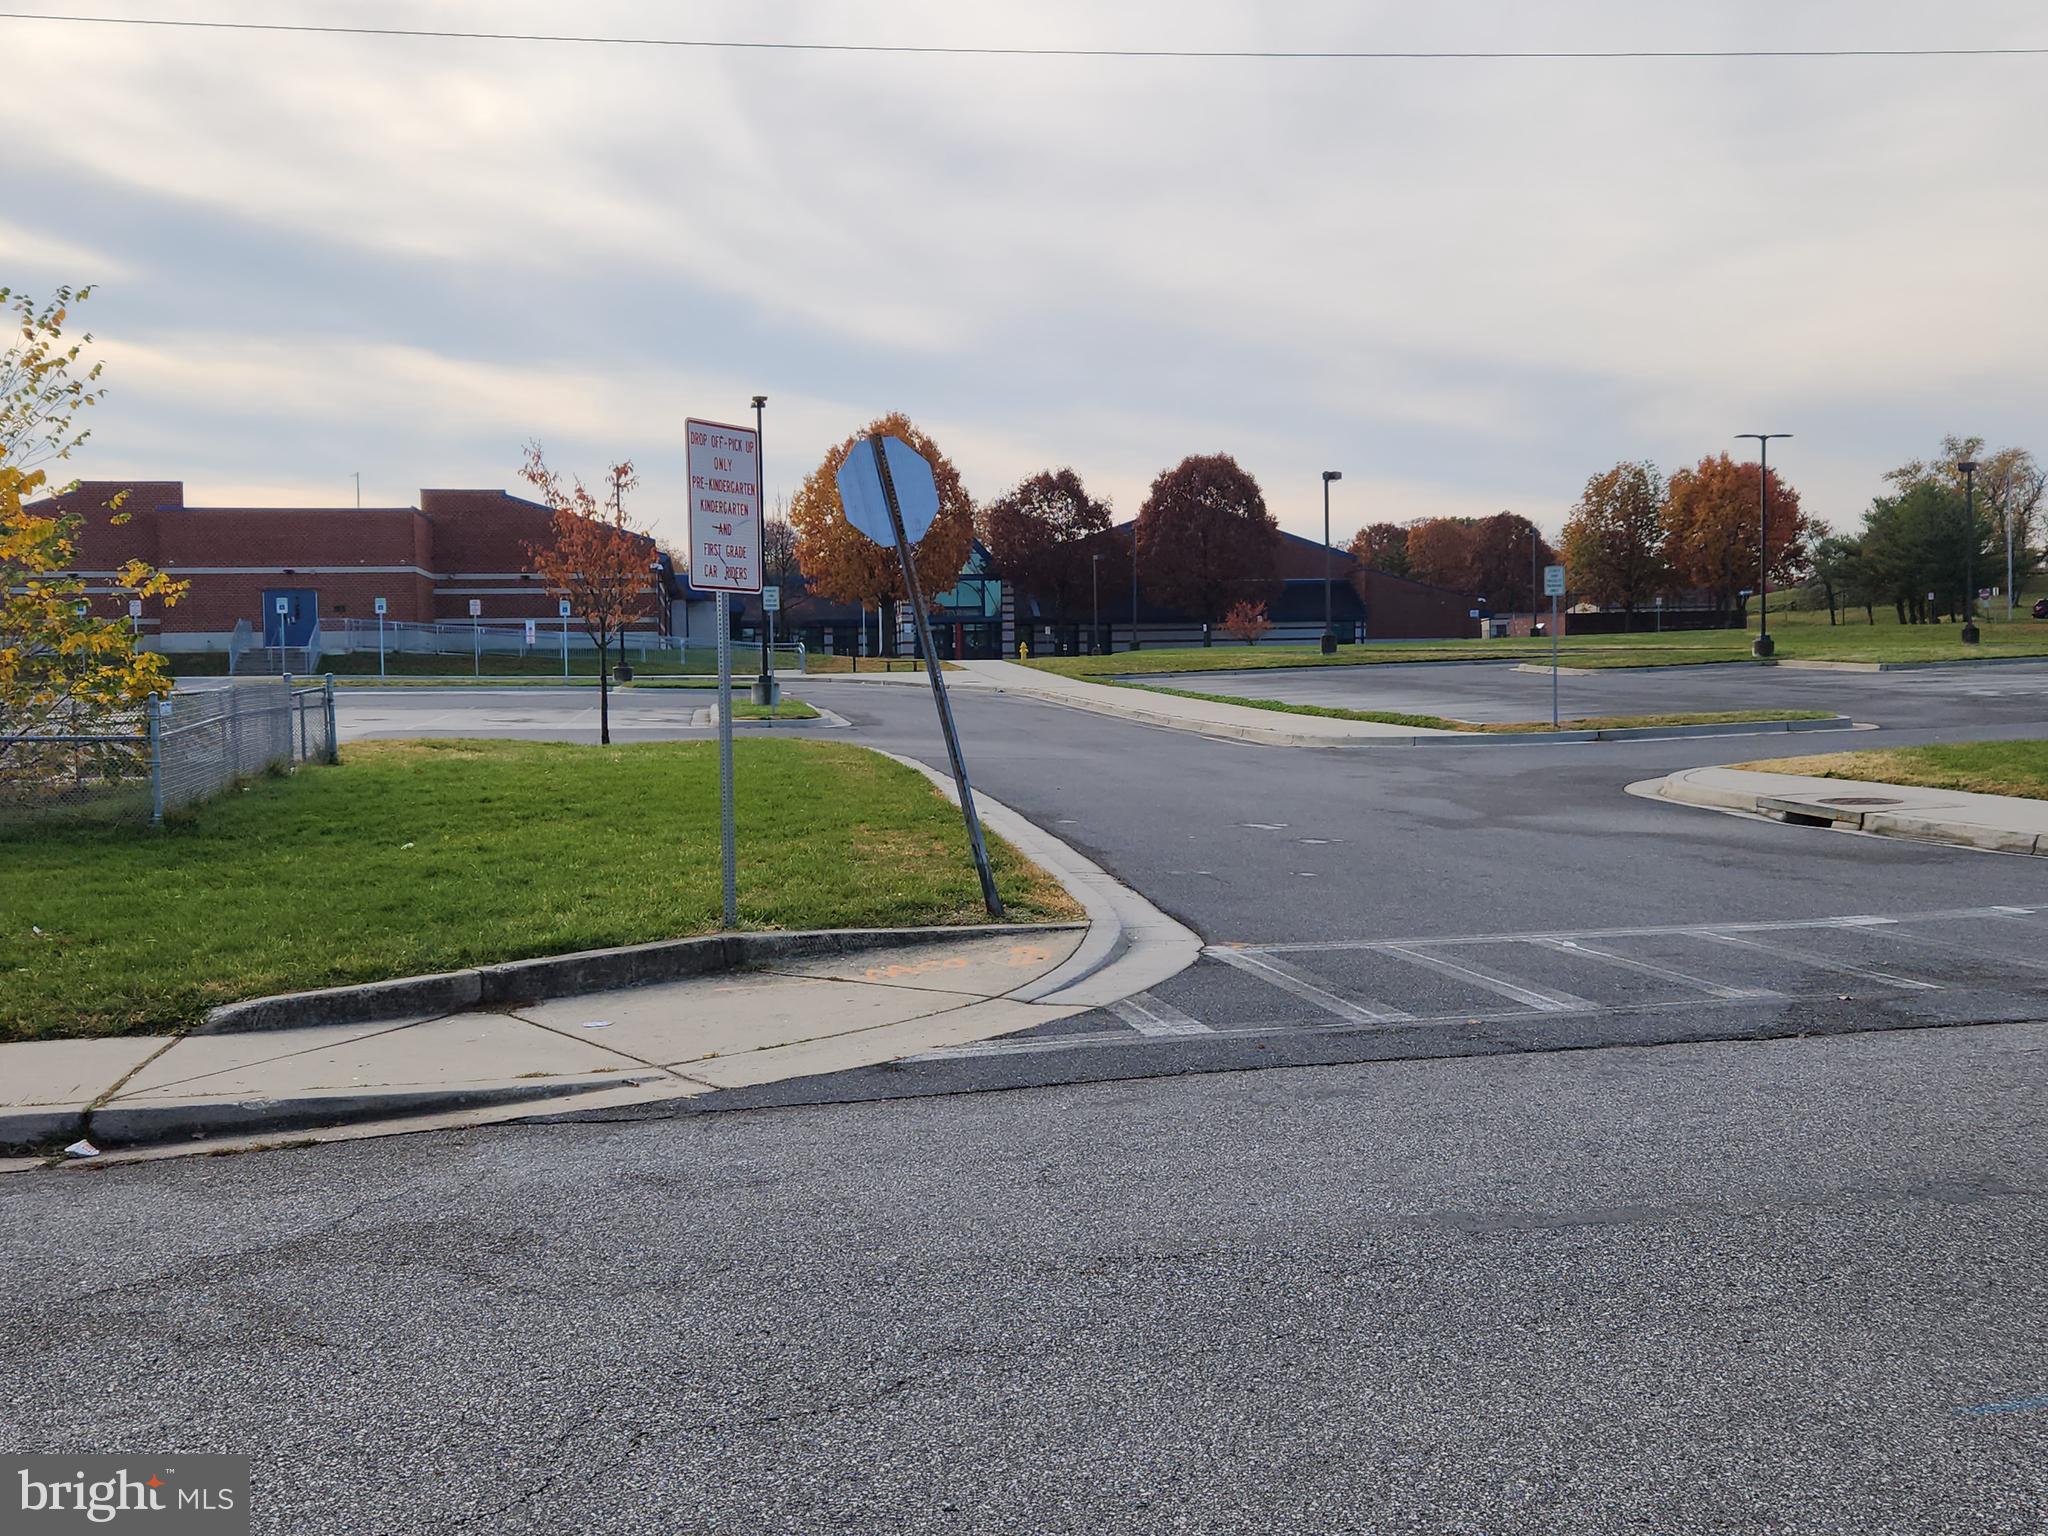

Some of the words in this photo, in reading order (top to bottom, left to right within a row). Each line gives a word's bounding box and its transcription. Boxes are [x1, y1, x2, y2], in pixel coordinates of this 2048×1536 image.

[690, 431, 708, 448] DROP
[745, 440, 754, 454] UP
[713, 456, 733, 472] ONLY
[692, 475, 756, 497] PRE-KINDERGARTEN
[700, 499, 749, 518] KINDERGARTEN
[718, 523, 733, 536] AND
[703, 542, 722, 557] FIRST
[725, 544, 747, 559] GRADE
[704, 563, 718, 578] CAR
[725, 566, 748, 581] RIDERS
